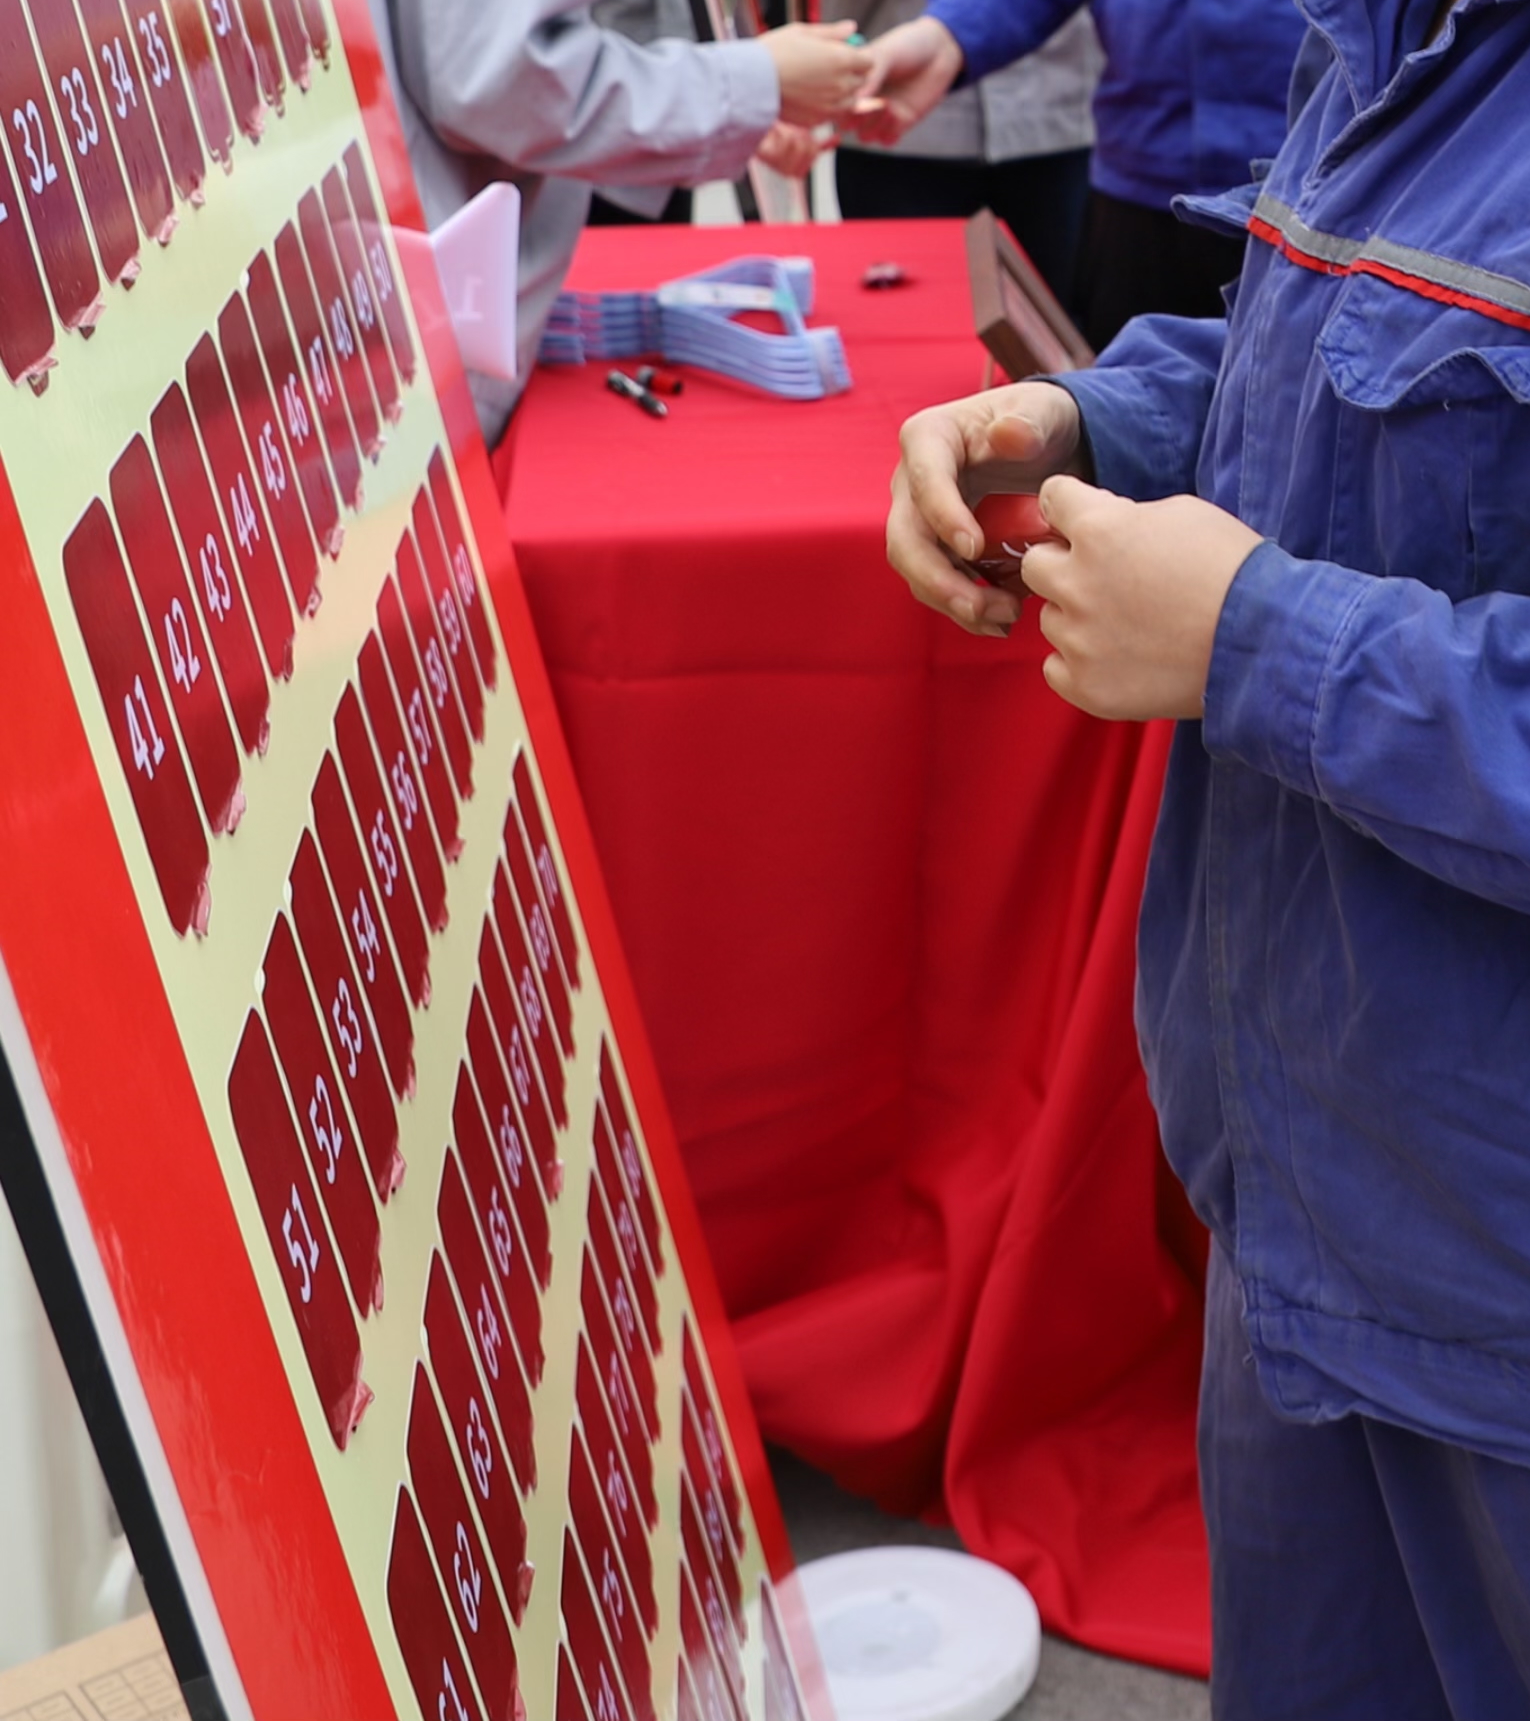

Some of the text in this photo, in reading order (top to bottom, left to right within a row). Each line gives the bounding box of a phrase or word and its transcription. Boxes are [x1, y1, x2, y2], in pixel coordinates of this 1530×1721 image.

[101, 39, 137, 119] 34
[139, 12, 171, 87] 35
[13, 100, 58, 194] 32
[61, 68, 99, 156] 33
[352, 270, 374, 331] 49
[370, 241, 392, 301] 50
[308, 335, 332, 405] 47
[331, 298, 353, 357] 48
[283, 371, 309, 447] 46
[257, 419, 287, 502] 45
[229, 471, 258, 558] 44
[199, 532, 232, 623] 43
[163, 596, 201, 694] 42
[125, 679, 165, 777] 41
[408, 687, 432, 766] 57
[393, 754, 418, 828] 56
[371, 808, 401, 898] 55
[352, 887, 382, 985] 54
[332, 979, 362, 1076] 53
[509, 1024, 531, 1107] 67
[309, 1076, 343, 1183] 52
[499, 1104, 524, 1187] 66
[282, 1188, 320, 1302] 51
[488, 1185, 513, 1277] 65
[477, 1283, 503, 1380] 64
[467, 1400, 492, 1498] 63
[453, 1524, 481, 1632] 62
